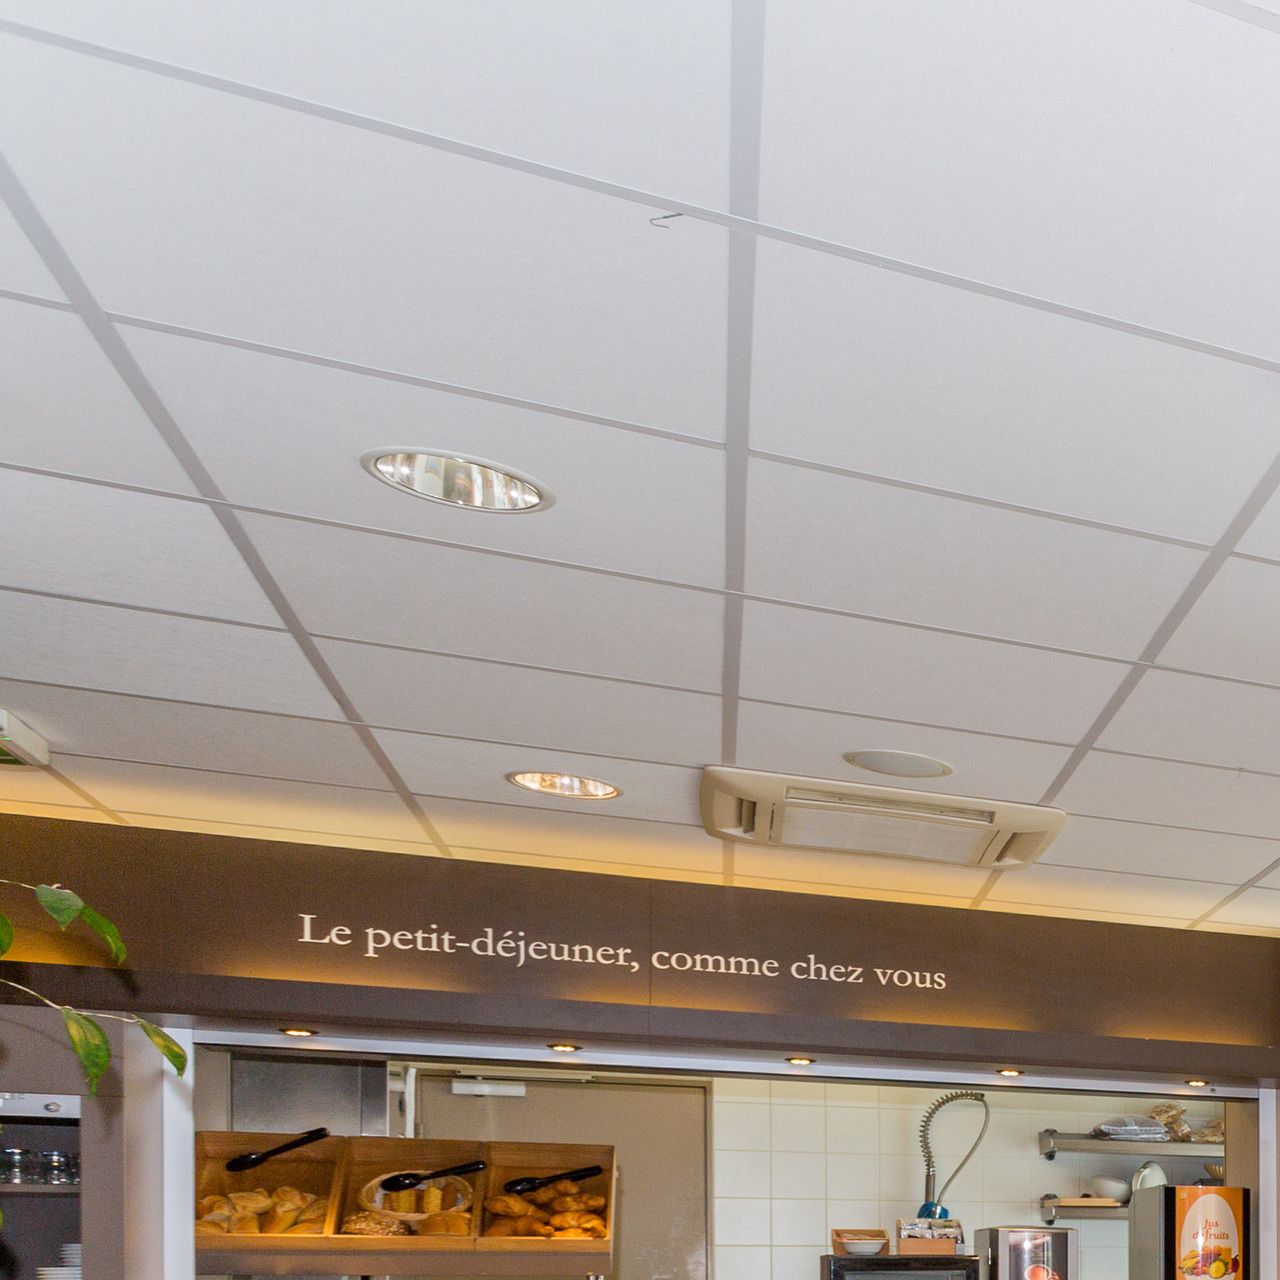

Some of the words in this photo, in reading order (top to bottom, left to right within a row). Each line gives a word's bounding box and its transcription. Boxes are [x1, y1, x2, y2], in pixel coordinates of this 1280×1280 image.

[297, 913, 352, 946] Le
[364, 923, 641, 973] petit-déjeuner,
[651, 949, 780, 978] comme
[790, 952, 864, 983] chez
[872, 967, 948, 990] vous
[1203, 1219, 1219, 1229] Jus
[1204, 1228, 1230, 1242] fruits
